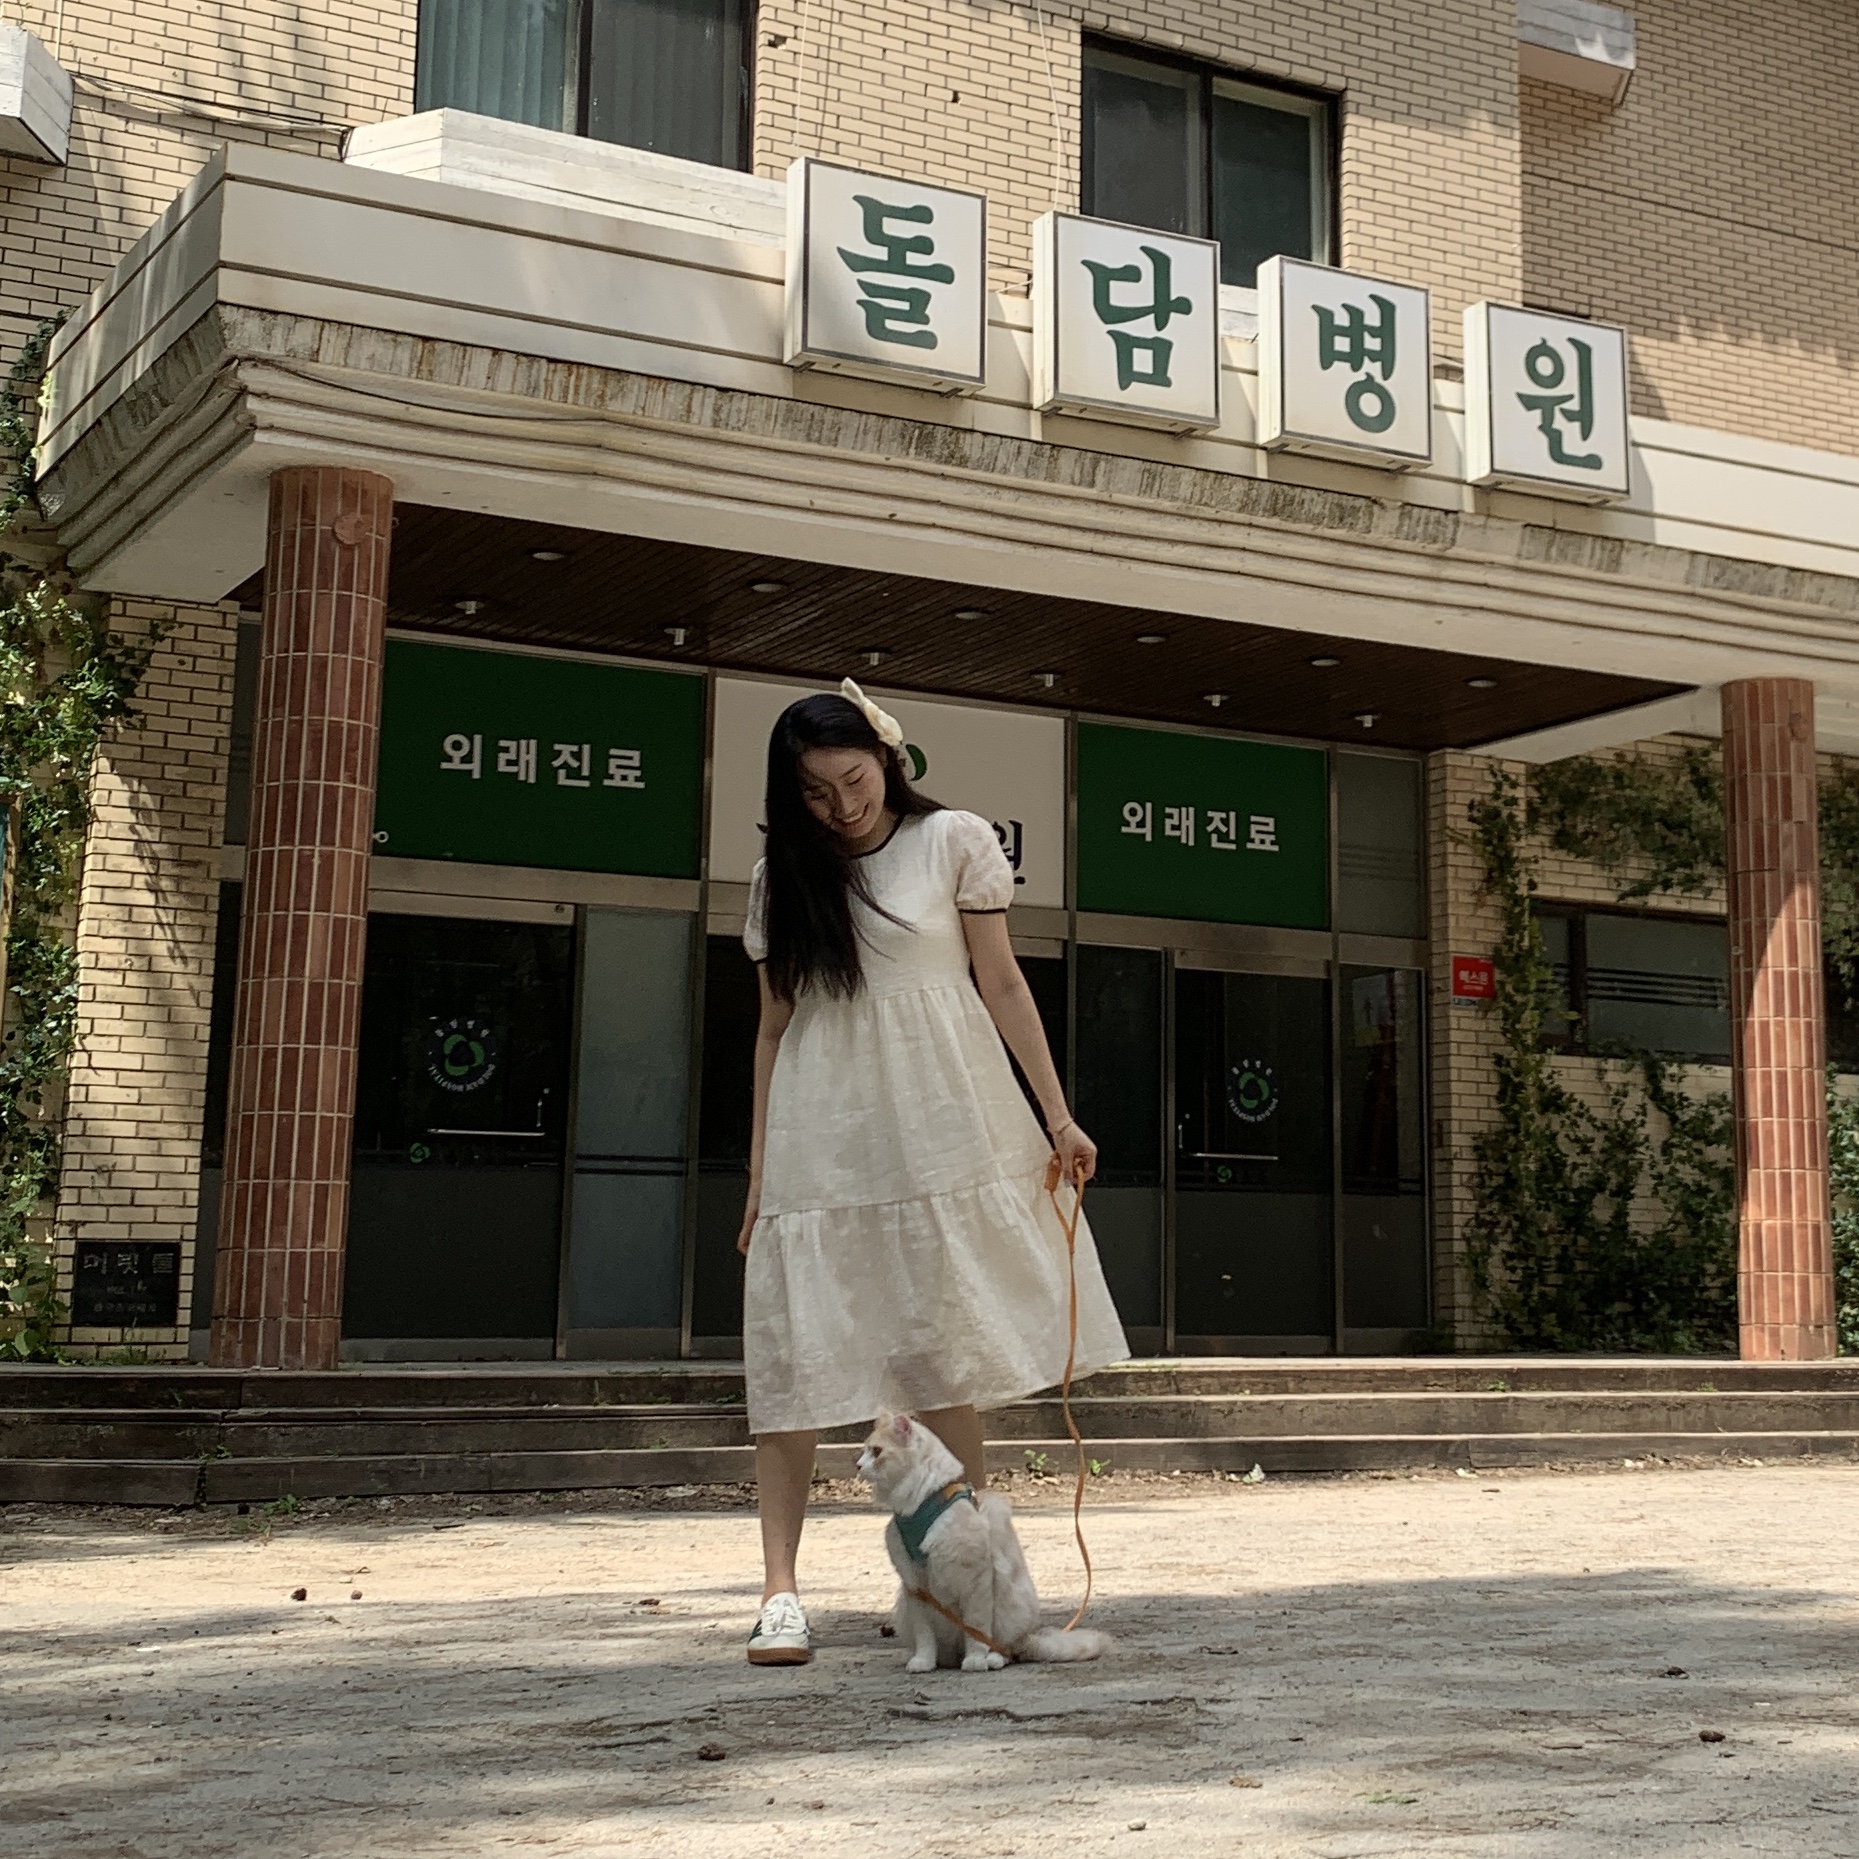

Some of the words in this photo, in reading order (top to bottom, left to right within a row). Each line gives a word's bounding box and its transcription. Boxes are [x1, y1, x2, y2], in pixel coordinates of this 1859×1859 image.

[837, 194, 1603, 470] 돌담병원
[441, 735, 644, 788] 외래진료
[1122, 802, 1278, 851] 외래진료
